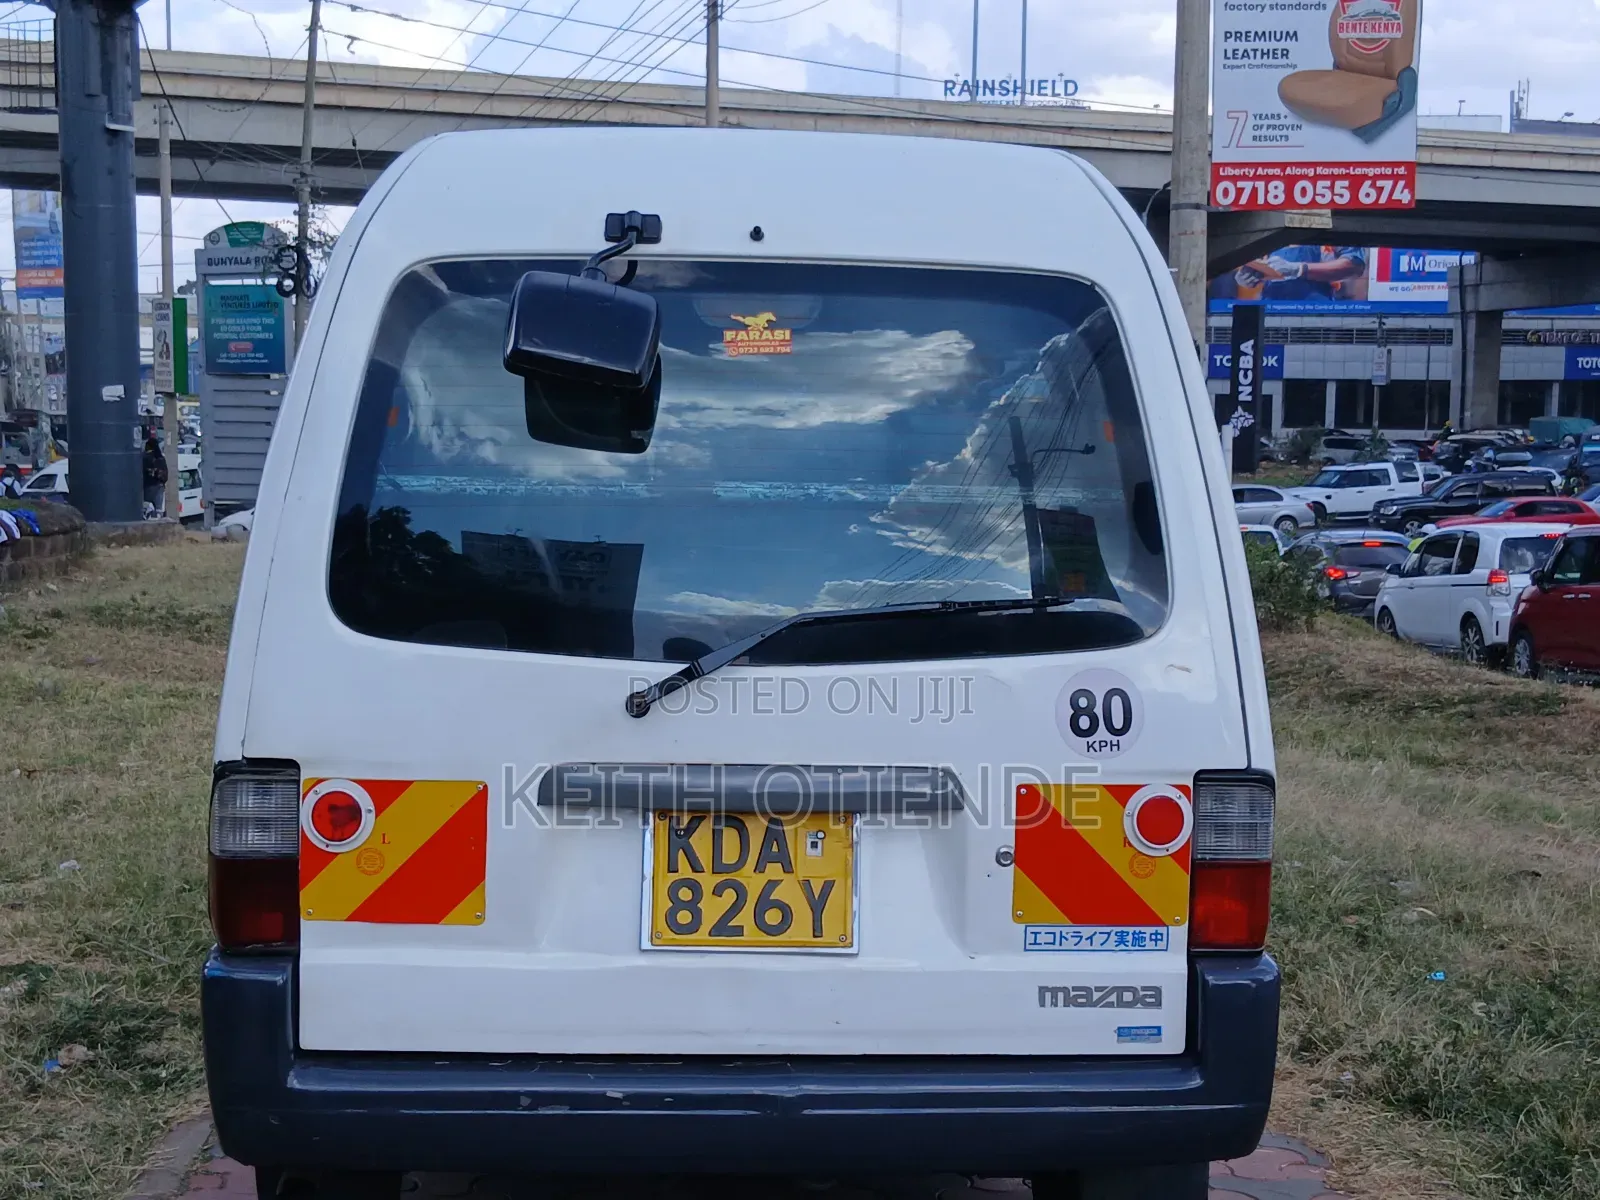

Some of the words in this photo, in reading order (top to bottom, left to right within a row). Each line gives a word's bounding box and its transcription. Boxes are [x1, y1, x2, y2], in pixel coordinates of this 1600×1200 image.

[1224, 2, 1266, 13] factory
[1268, 1, 1327, 11] standards
[1338, 21, 1369, 34] BENTE
[1370, 21, 1402, 34] KENYA
[1224, 30, 1299, 43] PREMIUM
[1223, 48, 1290, 60] LEATHER
[943, 79, 1079, 97] RAINSHIELD
[1252, 113, 1281, 121] YEARS
[1252, 124, 1264, 132] OF
[1219, 166, 1255, 177] Liberty
[1285, 166, 1315, 177] Along
[1316, 165, 1391, 176] Karen-Langata
[1393, 165, 1408, 175] rd.
[1215, 180, 1286, 206] 0718
[1293, 180, 1351, 205] 055
[1358, 180, 1412, 204] 674
[207, 255, 252, 266] BUNYALA
[724, 329, 791, 341] FARASI
[1238, 339, 1254, 401] NCBA
[1069, 687, 1132, 738] 80
[1086, 739, 1120, 753] KPH
[380, 833, 391, 845] L
[667, 814, 794, 874] KDA
[665, 877, 836, 938] 826Y
[1028, 929, 1165, 948] エコドライブ実施中
